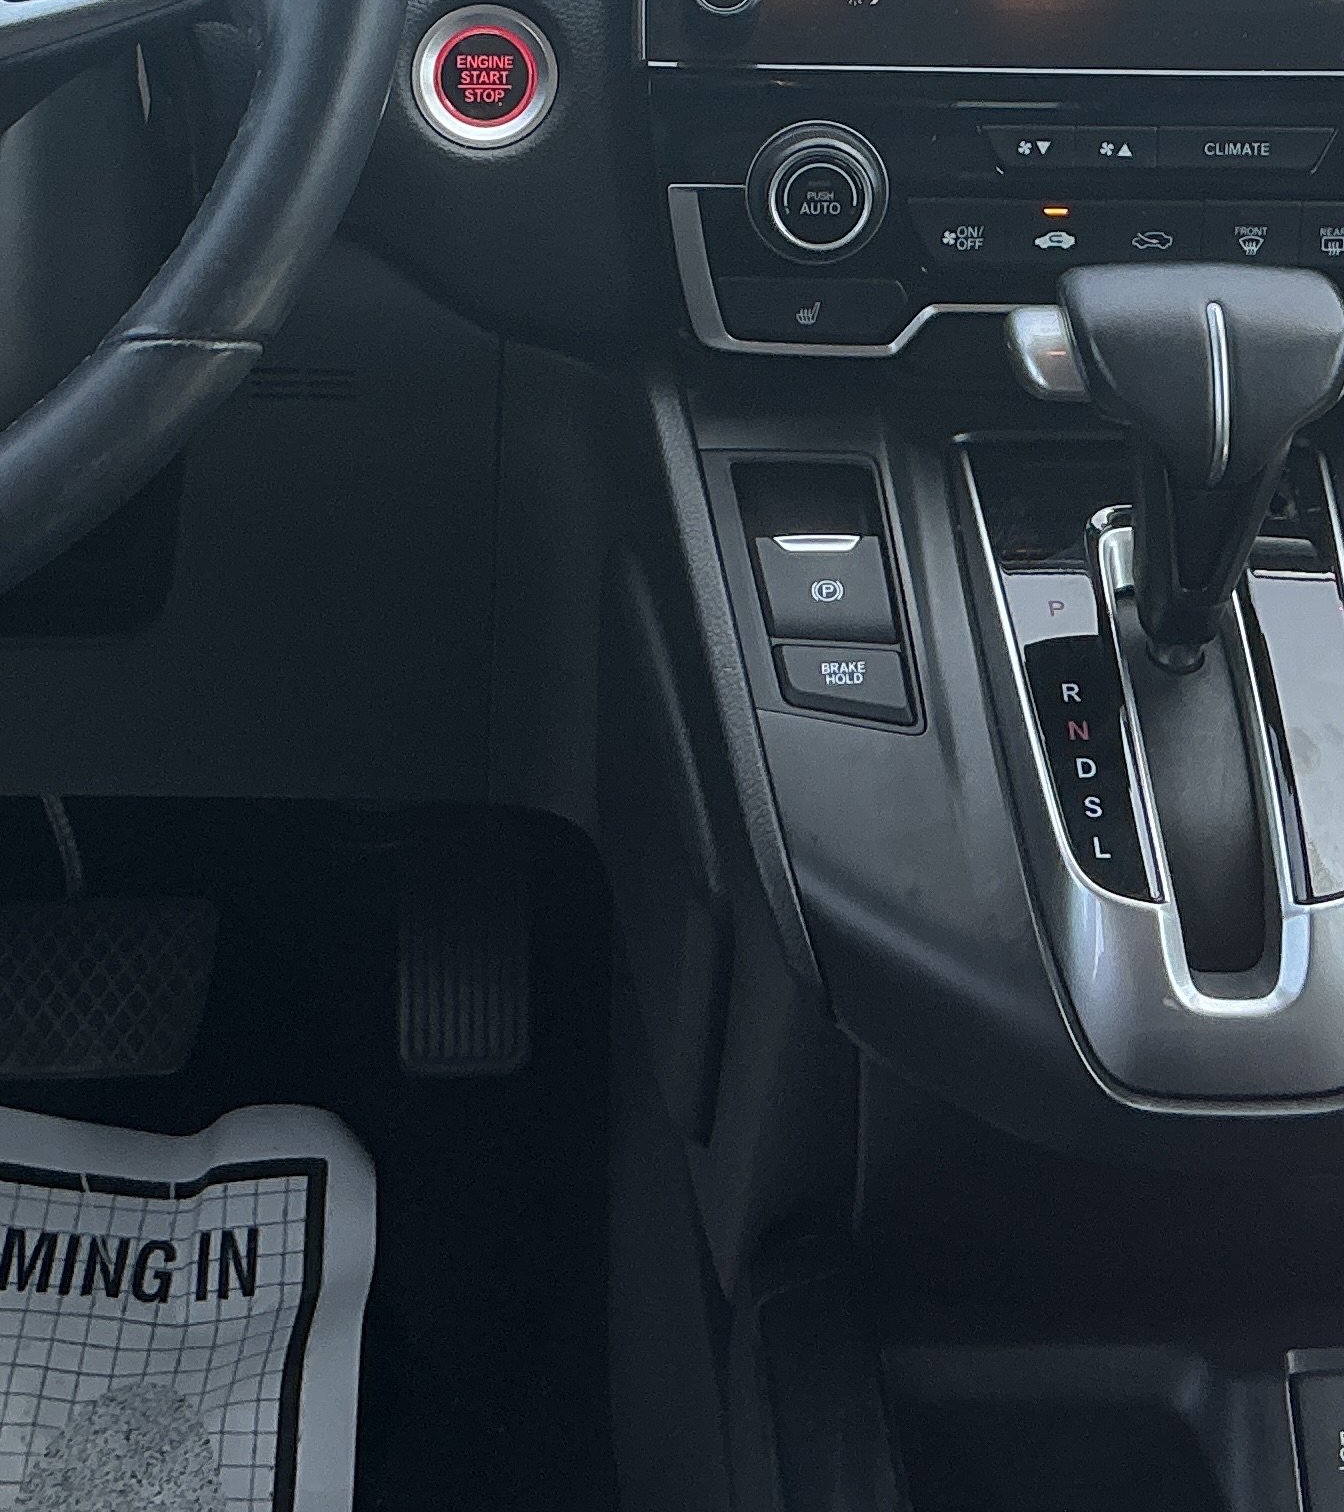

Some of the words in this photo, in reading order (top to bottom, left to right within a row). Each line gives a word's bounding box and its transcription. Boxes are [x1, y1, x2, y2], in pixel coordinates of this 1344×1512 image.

[456, 55, 514, 69] ENGINE
[460, 71, 510, 85] START
[464, 89, 505, 103] STOP
[1204, 142, 1270, 156] CLIMATE
[807, 191, 834, 201] PUSH
[799, 201, 841, 216] AUTO
[957, 225, 984, 238] ON/
[1234, 226, 1268, 237] FRONT
[957, 238, 984, 251] OFF
[1048, 600, 1065, 617] P
[821, 661, 866, 674] BRAKE
[825, 672, 863, 685] HOLD
[1062, 683, 1082, 702] R
[1068, 721, 1090, 741] N
[1076, 758, 1097, 778] D
[1084, 797, 1103, 818] S
[1093, 837, 1112, 859] L
[194, 1228, 258, 1302] IN
